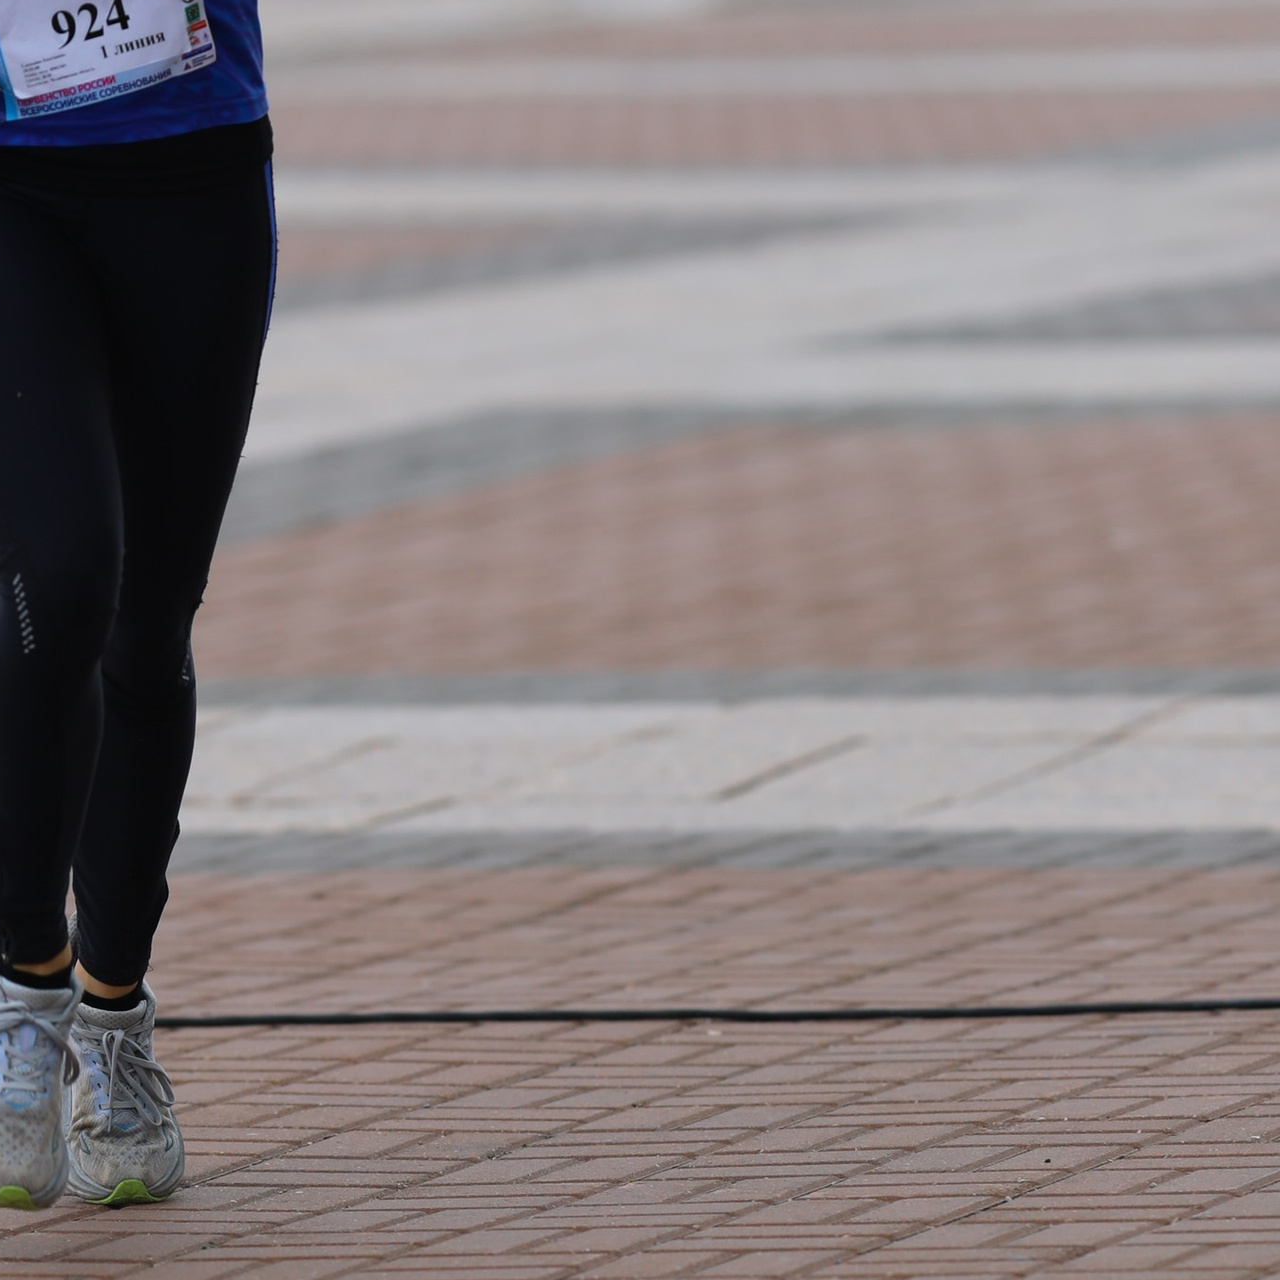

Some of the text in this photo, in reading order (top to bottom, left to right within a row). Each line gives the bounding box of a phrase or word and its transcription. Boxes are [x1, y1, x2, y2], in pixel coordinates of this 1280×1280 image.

[100, 45, 108, 59] 1
[114, 31, 166, 57] линия
[78, 75, 116, 94] РОССИИ
[99, 69, 173, 98] СОРЕВНОВАНИЯ
